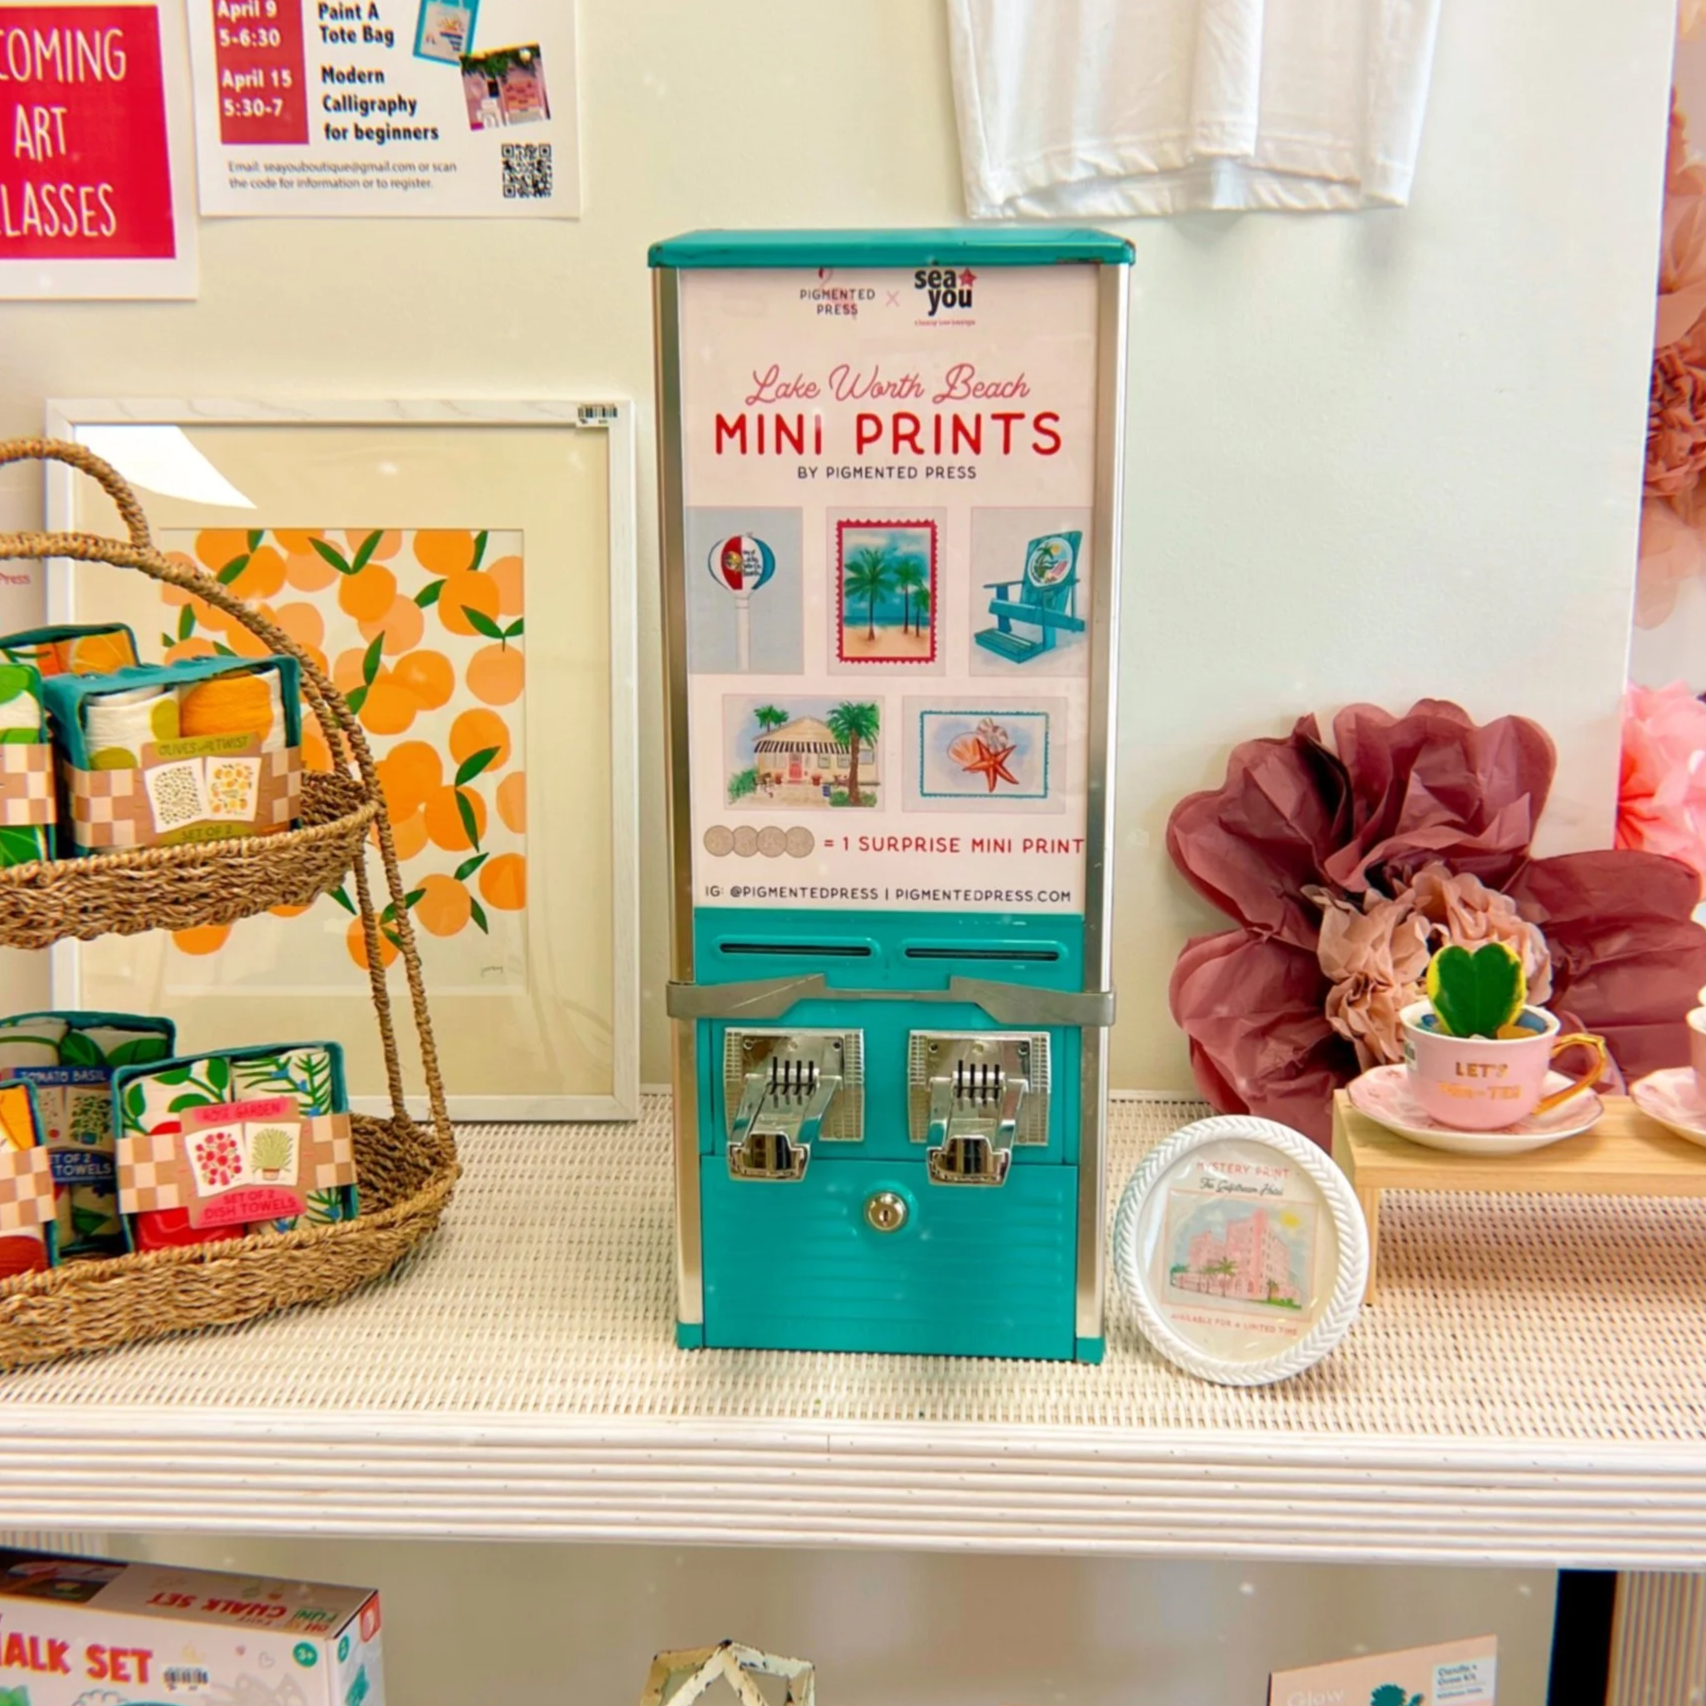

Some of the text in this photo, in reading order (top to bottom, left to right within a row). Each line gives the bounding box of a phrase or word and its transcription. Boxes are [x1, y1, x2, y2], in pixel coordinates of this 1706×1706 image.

[217, 0, 278, 21] April 9
[318, 2, 380, 20] Paint A
[219, 28, 281, 47] 5-6:30
[319, 26, 395, 47] Tote Bag
[222, 69, 292, 91] April 15
[321, 66, 385, 84] Modern
[223, 98, 284, 117] 5:30-7
[323, 95, 417, 117] Calligraphy
[15, 104, 67, 162] ART
[325, 123, 439, 145] for beginners
[419, 163, 430, 173] or
[433, 162, 457, 173] scan
[229, 178, 248, 188] the
[251, 178, 277, 189] code
[279, 178, 294, 188] for
[297, 178, 361, 189] information
[363, 180, 374, 189] or
[377, 179, 388, 189] to
[0, 181, 117, 237] LASSES
[914, 269, 957, 290] sea
[799, 288, 876, 301] PIGMENTED
[928, 289, 973, 317] you
[816, 304, 858, 316] PRESS
[745, 362, 1031, 406] Lake Worth Beach
[715, 411, 1063, 457] MINI PRINTS
[797, 466, 977, 480] BY PIGMENTED PRESS
[842, 837, 850, 852] 1
[858, 836, 961, 854] SURPRISE
[971, 838, 1013, 854] MINI
[1022, 838, 1084, 855] PRINT
[705, 886, 724, 897] IG:
[730, 886, 879, 901] @PIGMENTEDPRESS
[895, 888, 1072, 903] PIGMENTEDPRESS.COM
[73, 1070, 107, 1081] BASIL
[63, 1153, 80, 1164] OF
[54, 1163, 112, 1176] TOWELS
[204, 1196, 297, 1220] DISH TOWELS
[147, 1592, 287, 1619] CHALK SET
[0, 1631, 153, 1685] ALK SET
